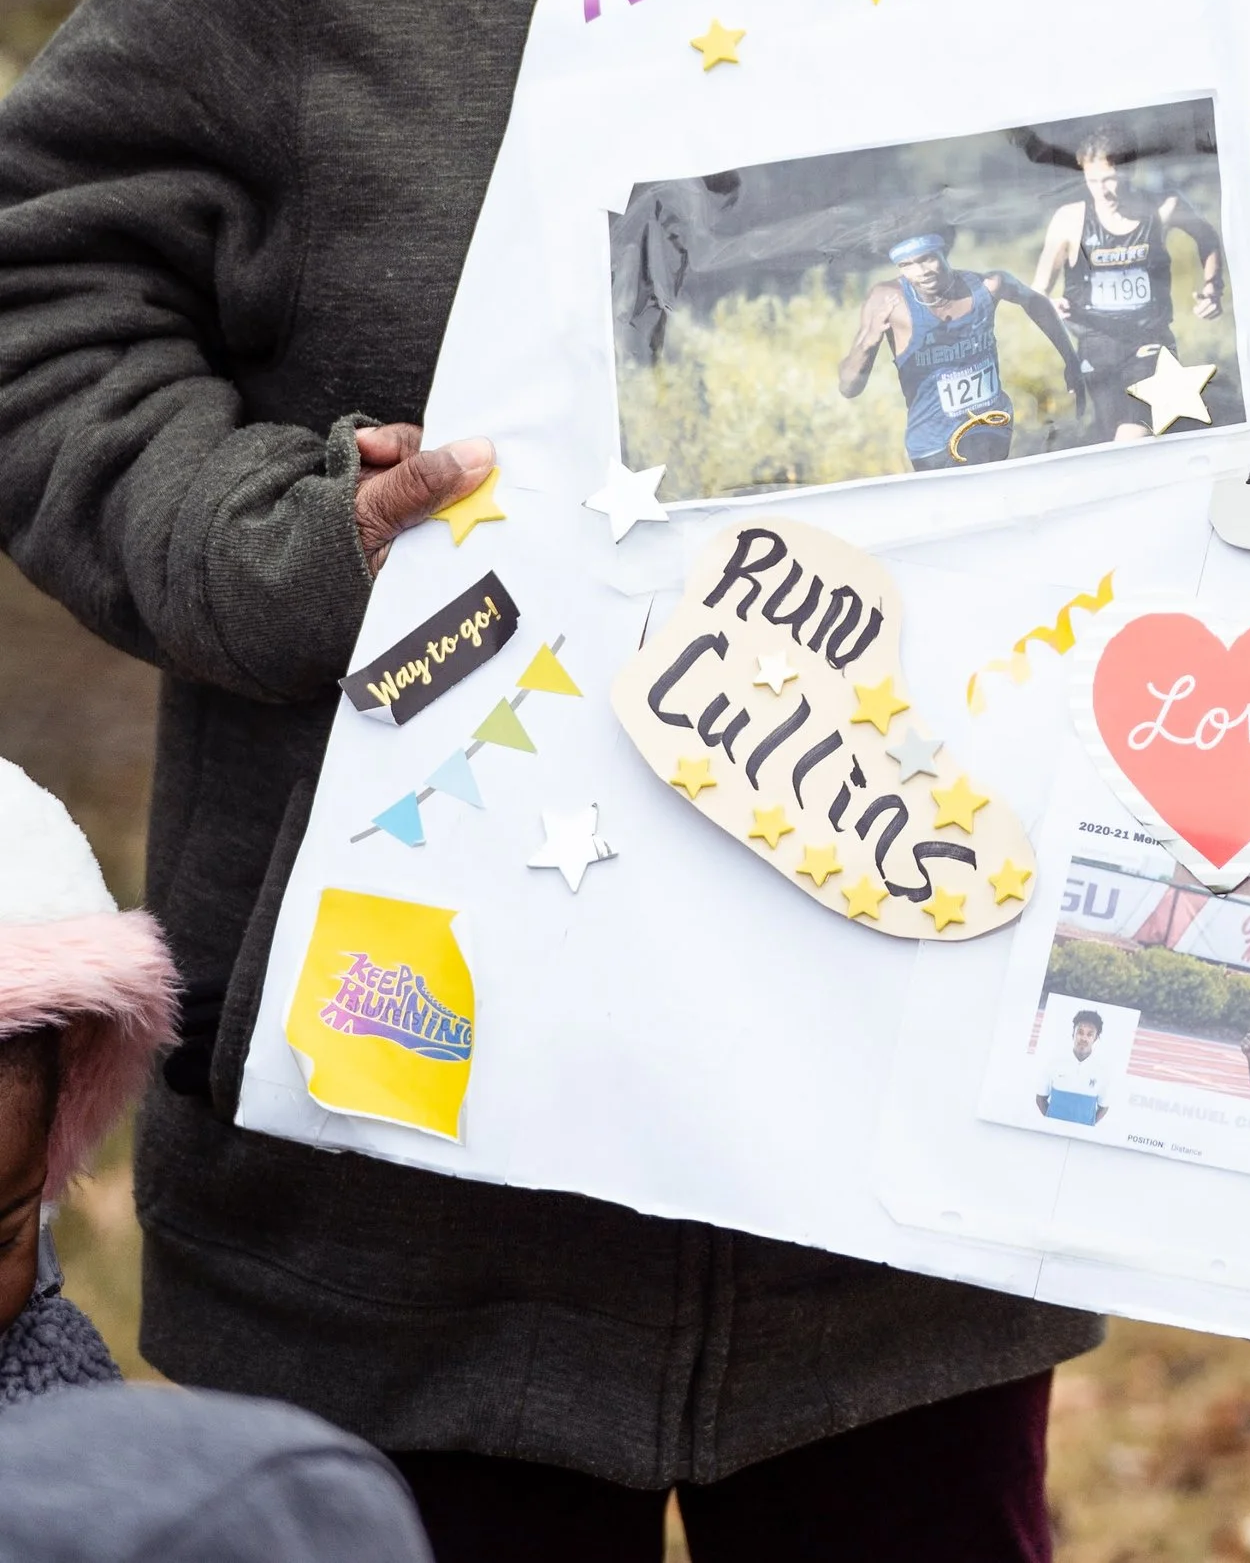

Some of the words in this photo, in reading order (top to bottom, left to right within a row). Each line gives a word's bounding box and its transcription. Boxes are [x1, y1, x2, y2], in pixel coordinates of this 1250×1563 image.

[1097, 276, 1148, 301] 1196
[943, 365, 995, 407] 1277
[367, 656, 433, 706] Way
[426, 633, 459, 664] to
[459, 595, 502, 648] go!
[648, 630, 978, 903] Cullins
[1078, 821, 1130, 840] 2020-21
[349, 953, 414, 997] KEEP
[1127, 1093, 1229, 1126] EMMANUEL
